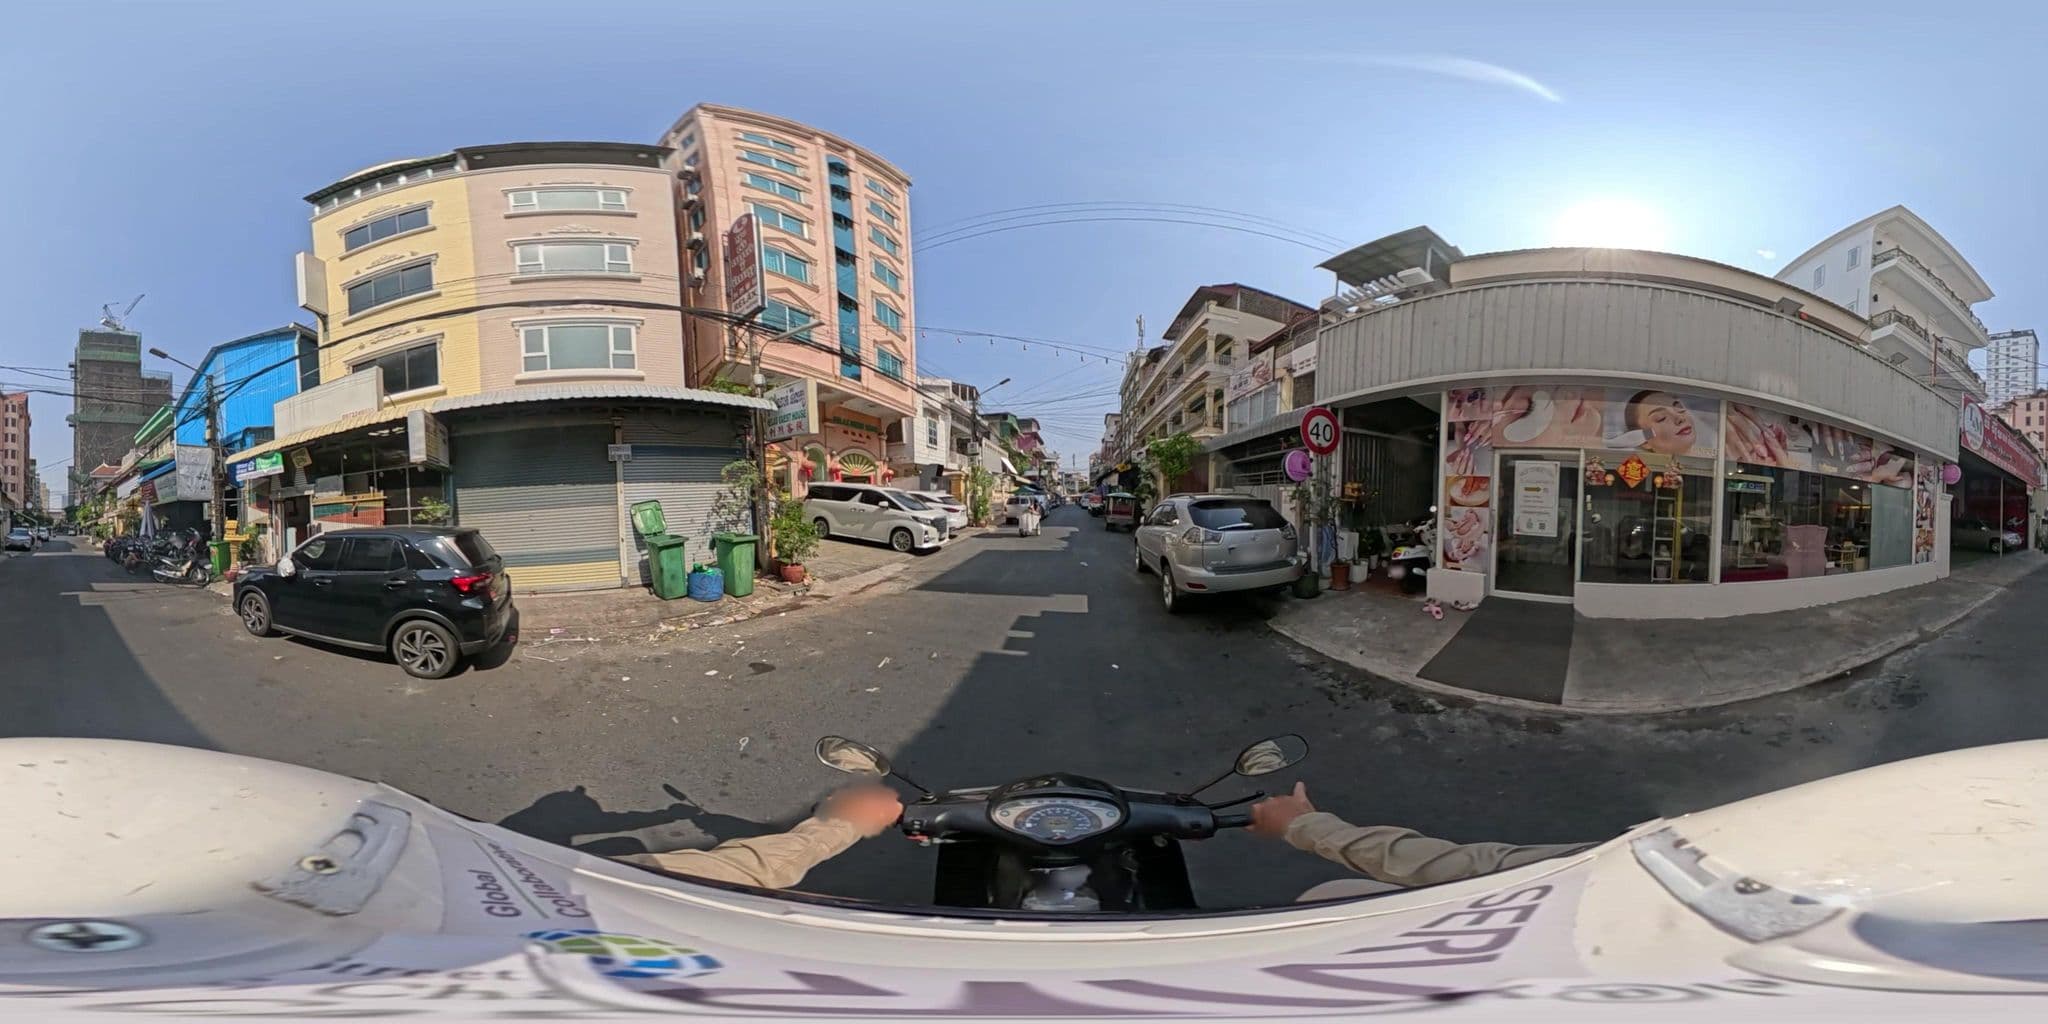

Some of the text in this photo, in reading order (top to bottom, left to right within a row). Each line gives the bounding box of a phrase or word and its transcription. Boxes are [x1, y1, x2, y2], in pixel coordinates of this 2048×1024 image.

[1310, 422, 1333, 442] 40
[467, 869, 522, 918] Global
[487, 842, 592, 919] Collaborative
